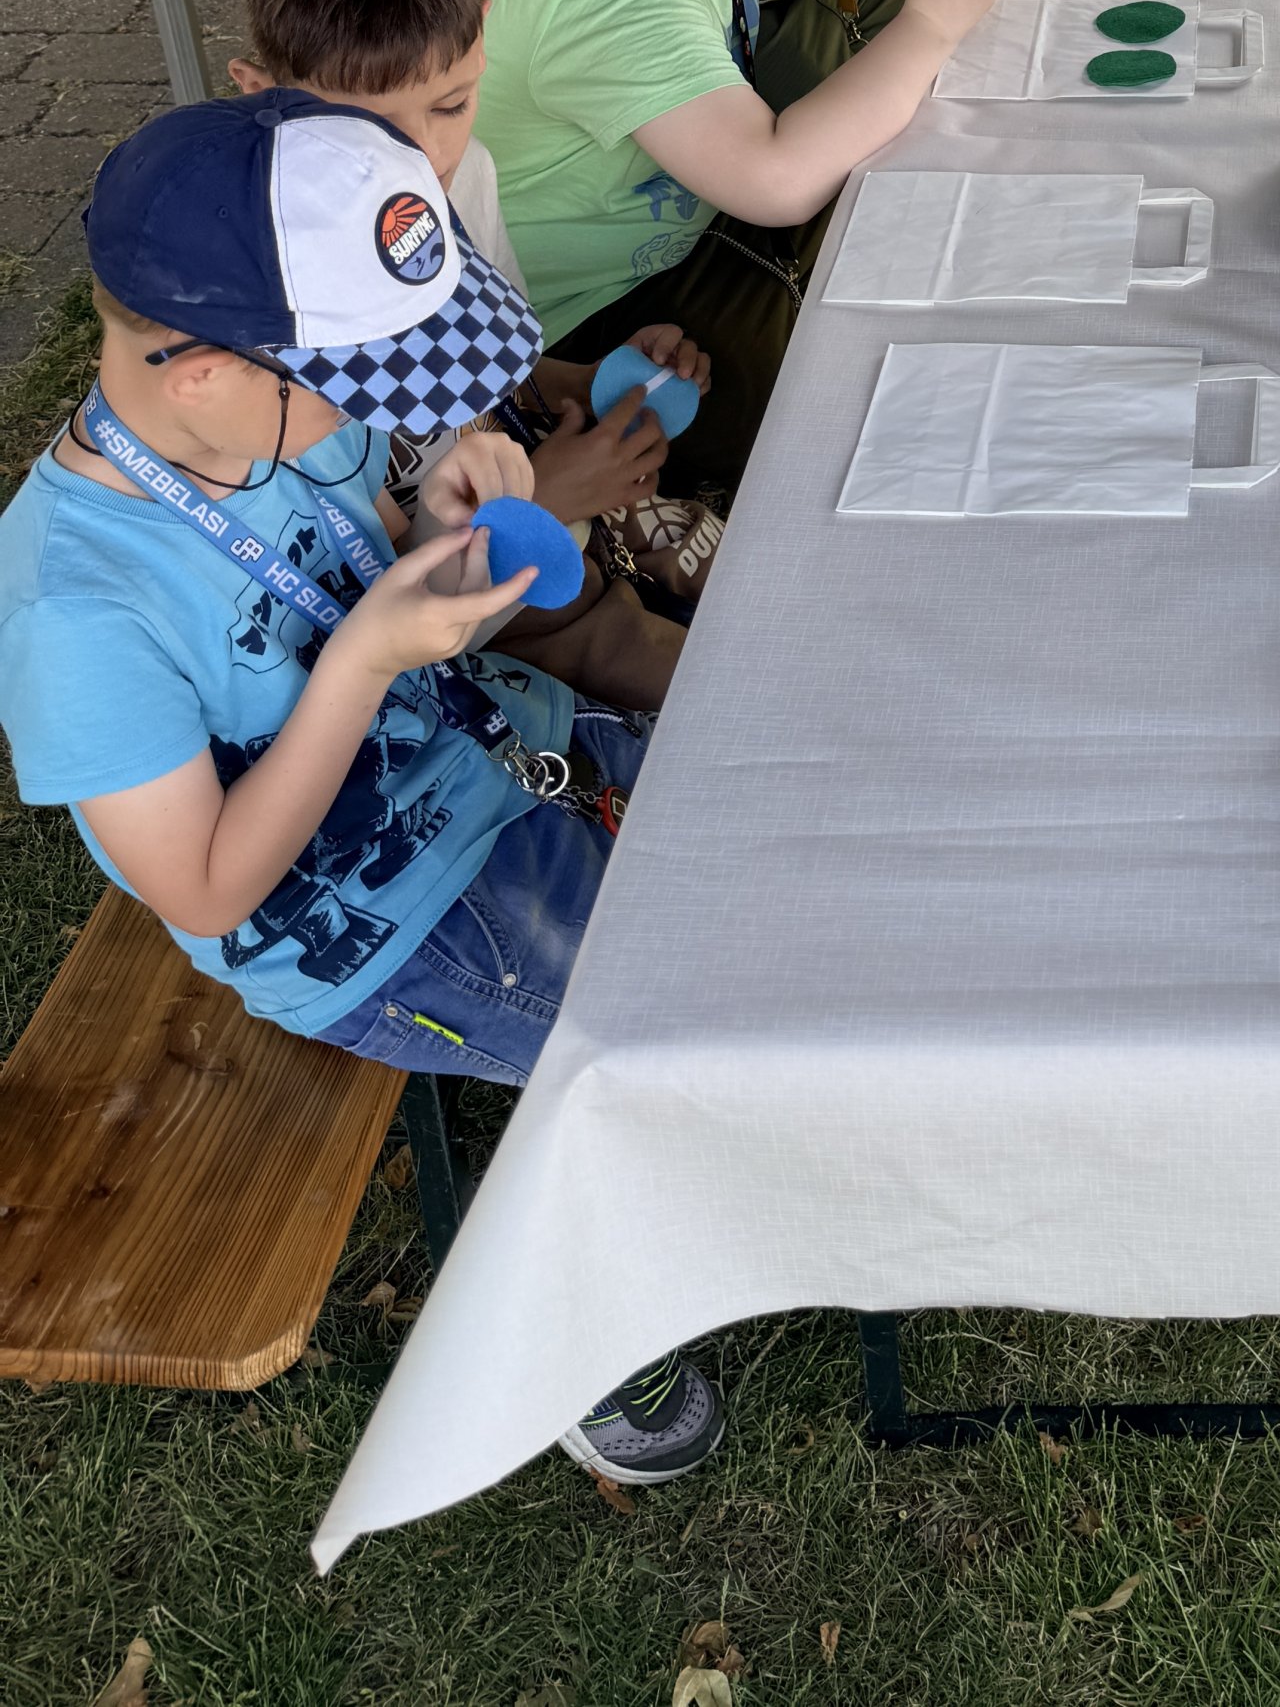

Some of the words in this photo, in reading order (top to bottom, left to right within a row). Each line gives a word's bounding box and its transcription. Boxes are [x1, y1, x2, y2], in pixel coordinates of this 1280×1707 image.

[389, 212, 434, 265] SURFING
[95, 418, 230, 538] #SMEBELASI
[346, 532, 385, 581] VAN
[264, 562, 300, 596] HC
[294, 586, 344, 626] SLO
